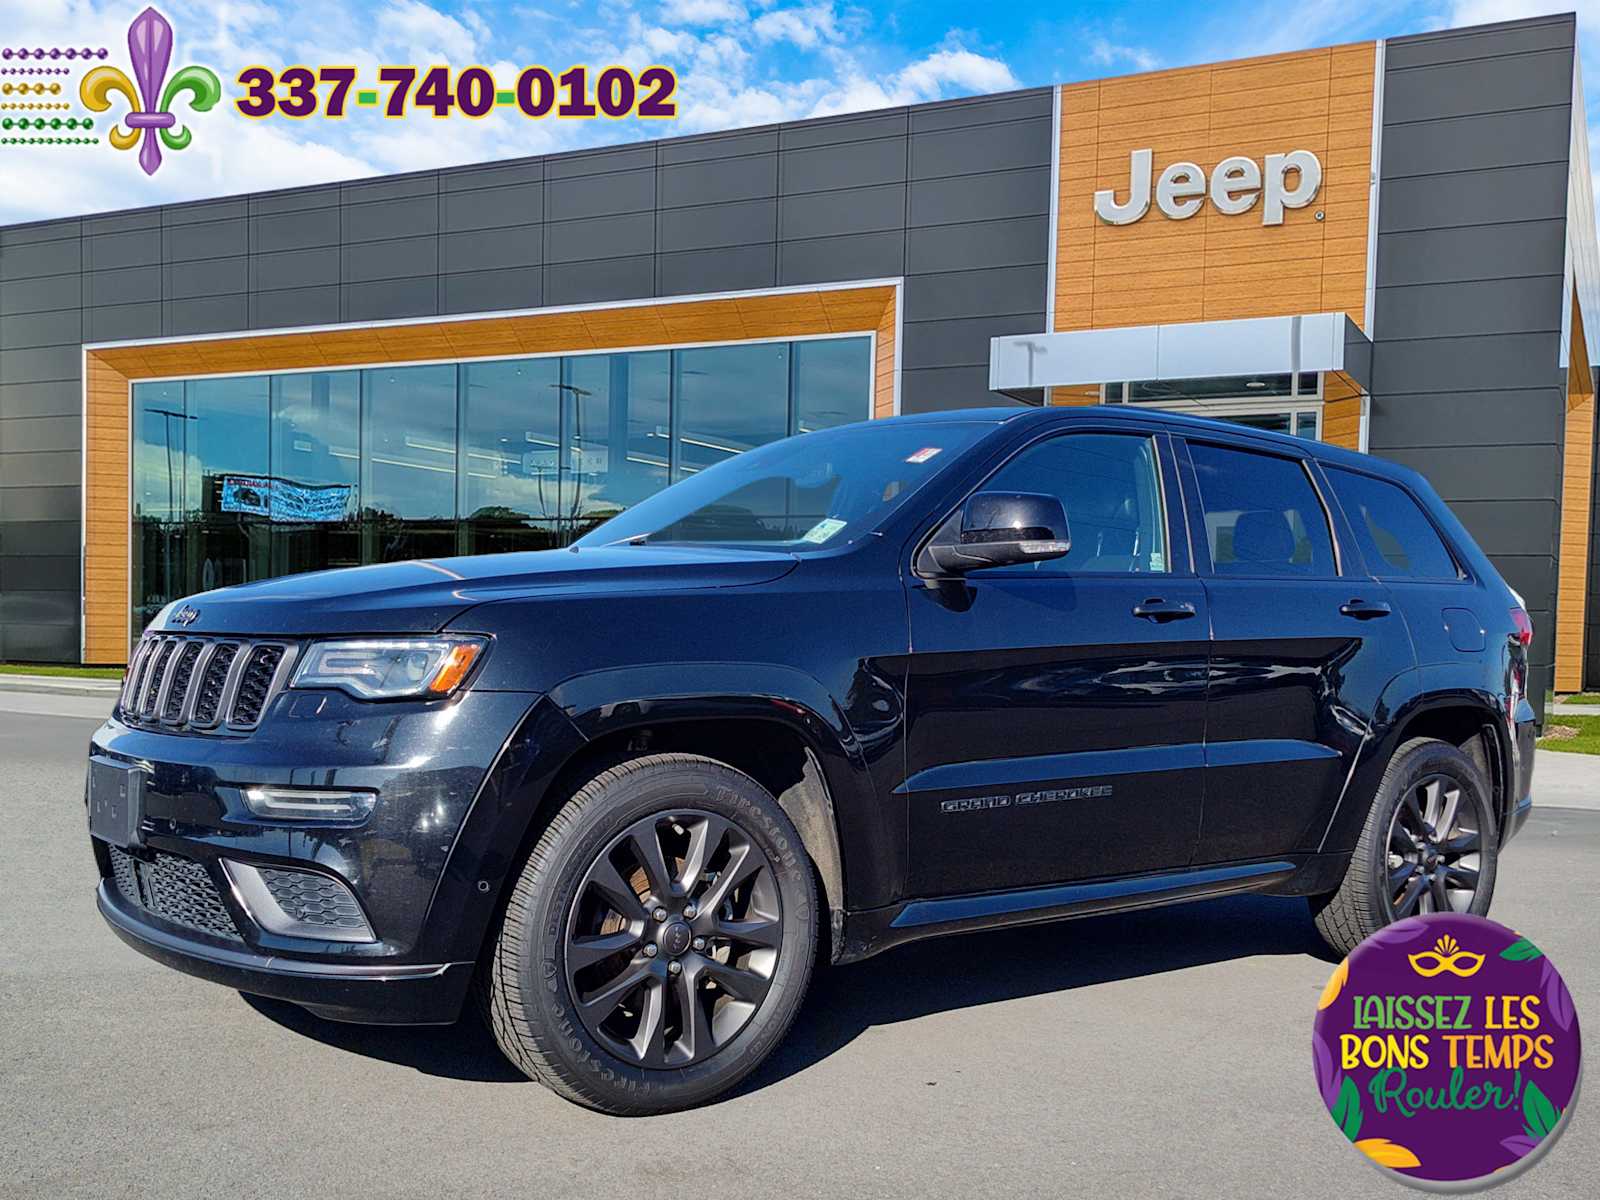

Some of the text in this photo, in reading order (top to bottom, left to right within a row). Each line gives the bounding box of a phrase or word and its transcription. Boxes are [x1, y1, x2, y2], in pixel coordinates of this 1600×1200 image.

[1094, 148, 1322, 226] Jeep
[941, 785, 1112, 812] GRAND CHEROKEE
